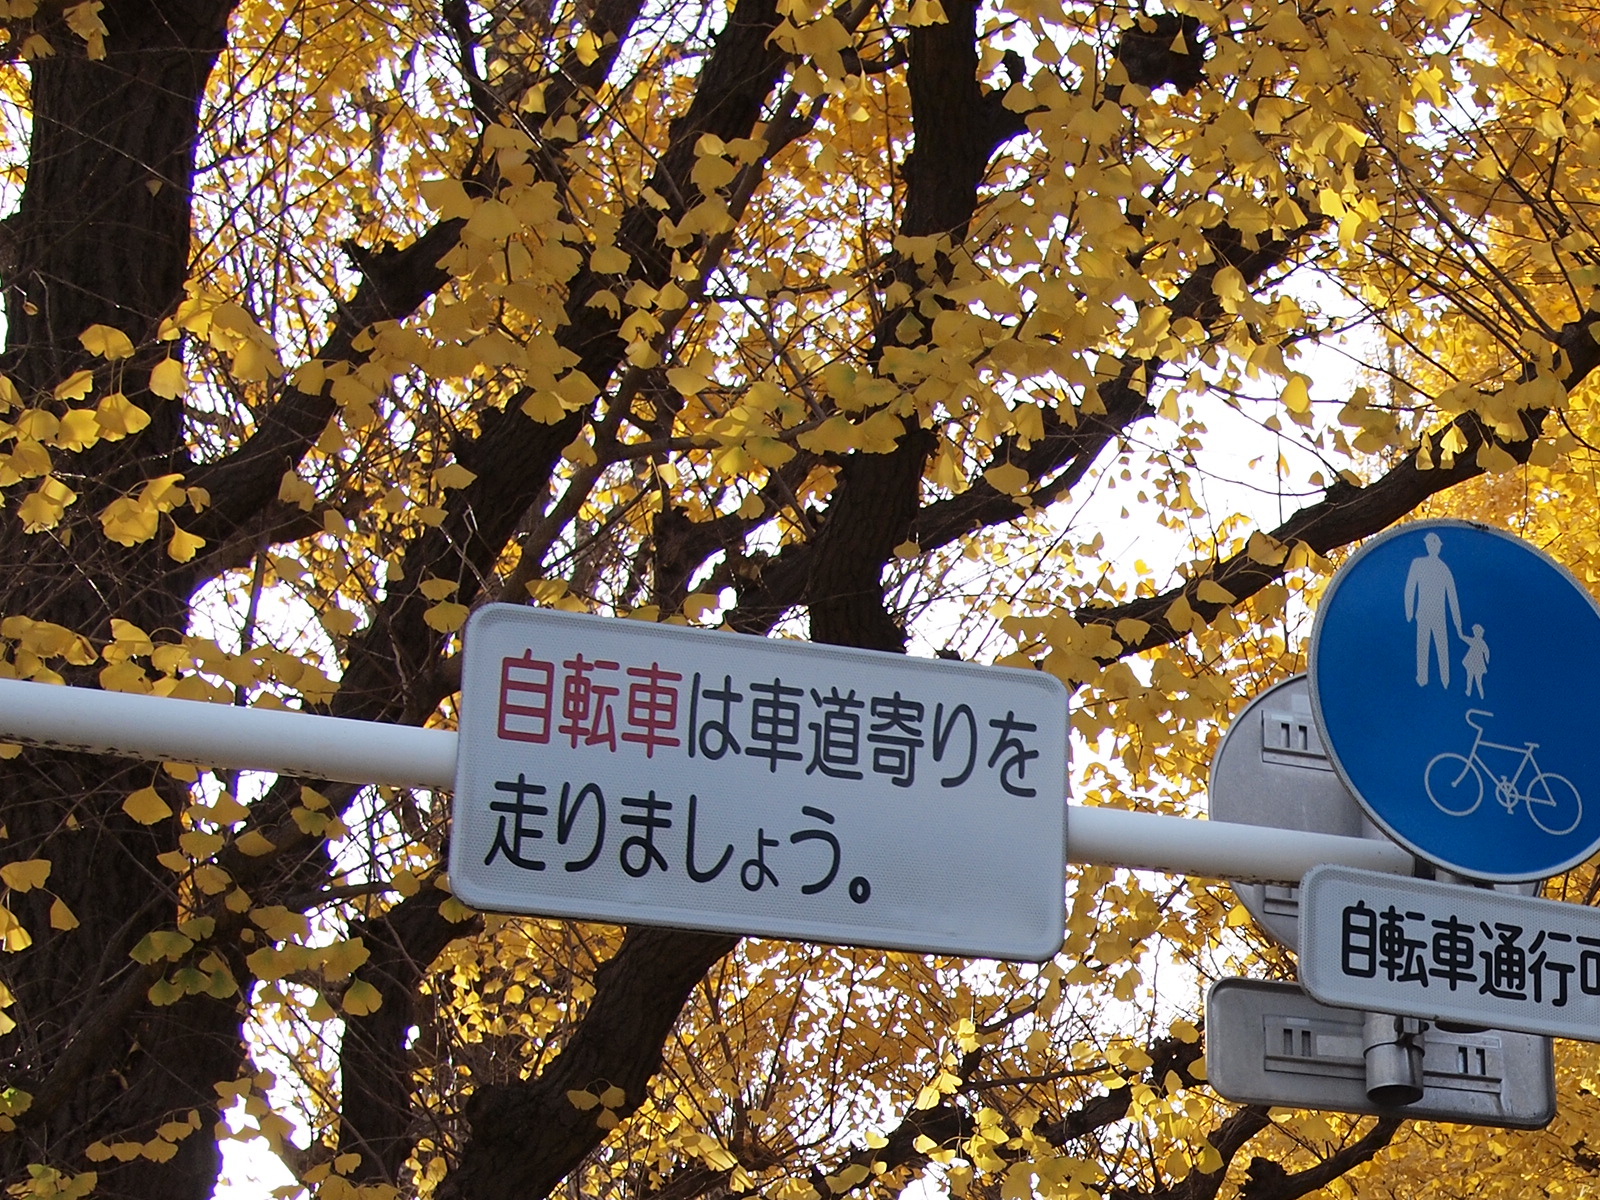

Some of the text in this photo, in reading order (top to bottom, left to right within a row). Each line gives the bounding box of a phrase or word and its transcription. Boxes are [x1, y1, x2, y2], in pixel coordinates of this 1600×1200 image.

[497, 648, 1040, 799] 自転車は車道寄りを
[484, 773, 872, 905] 走りましょう。
